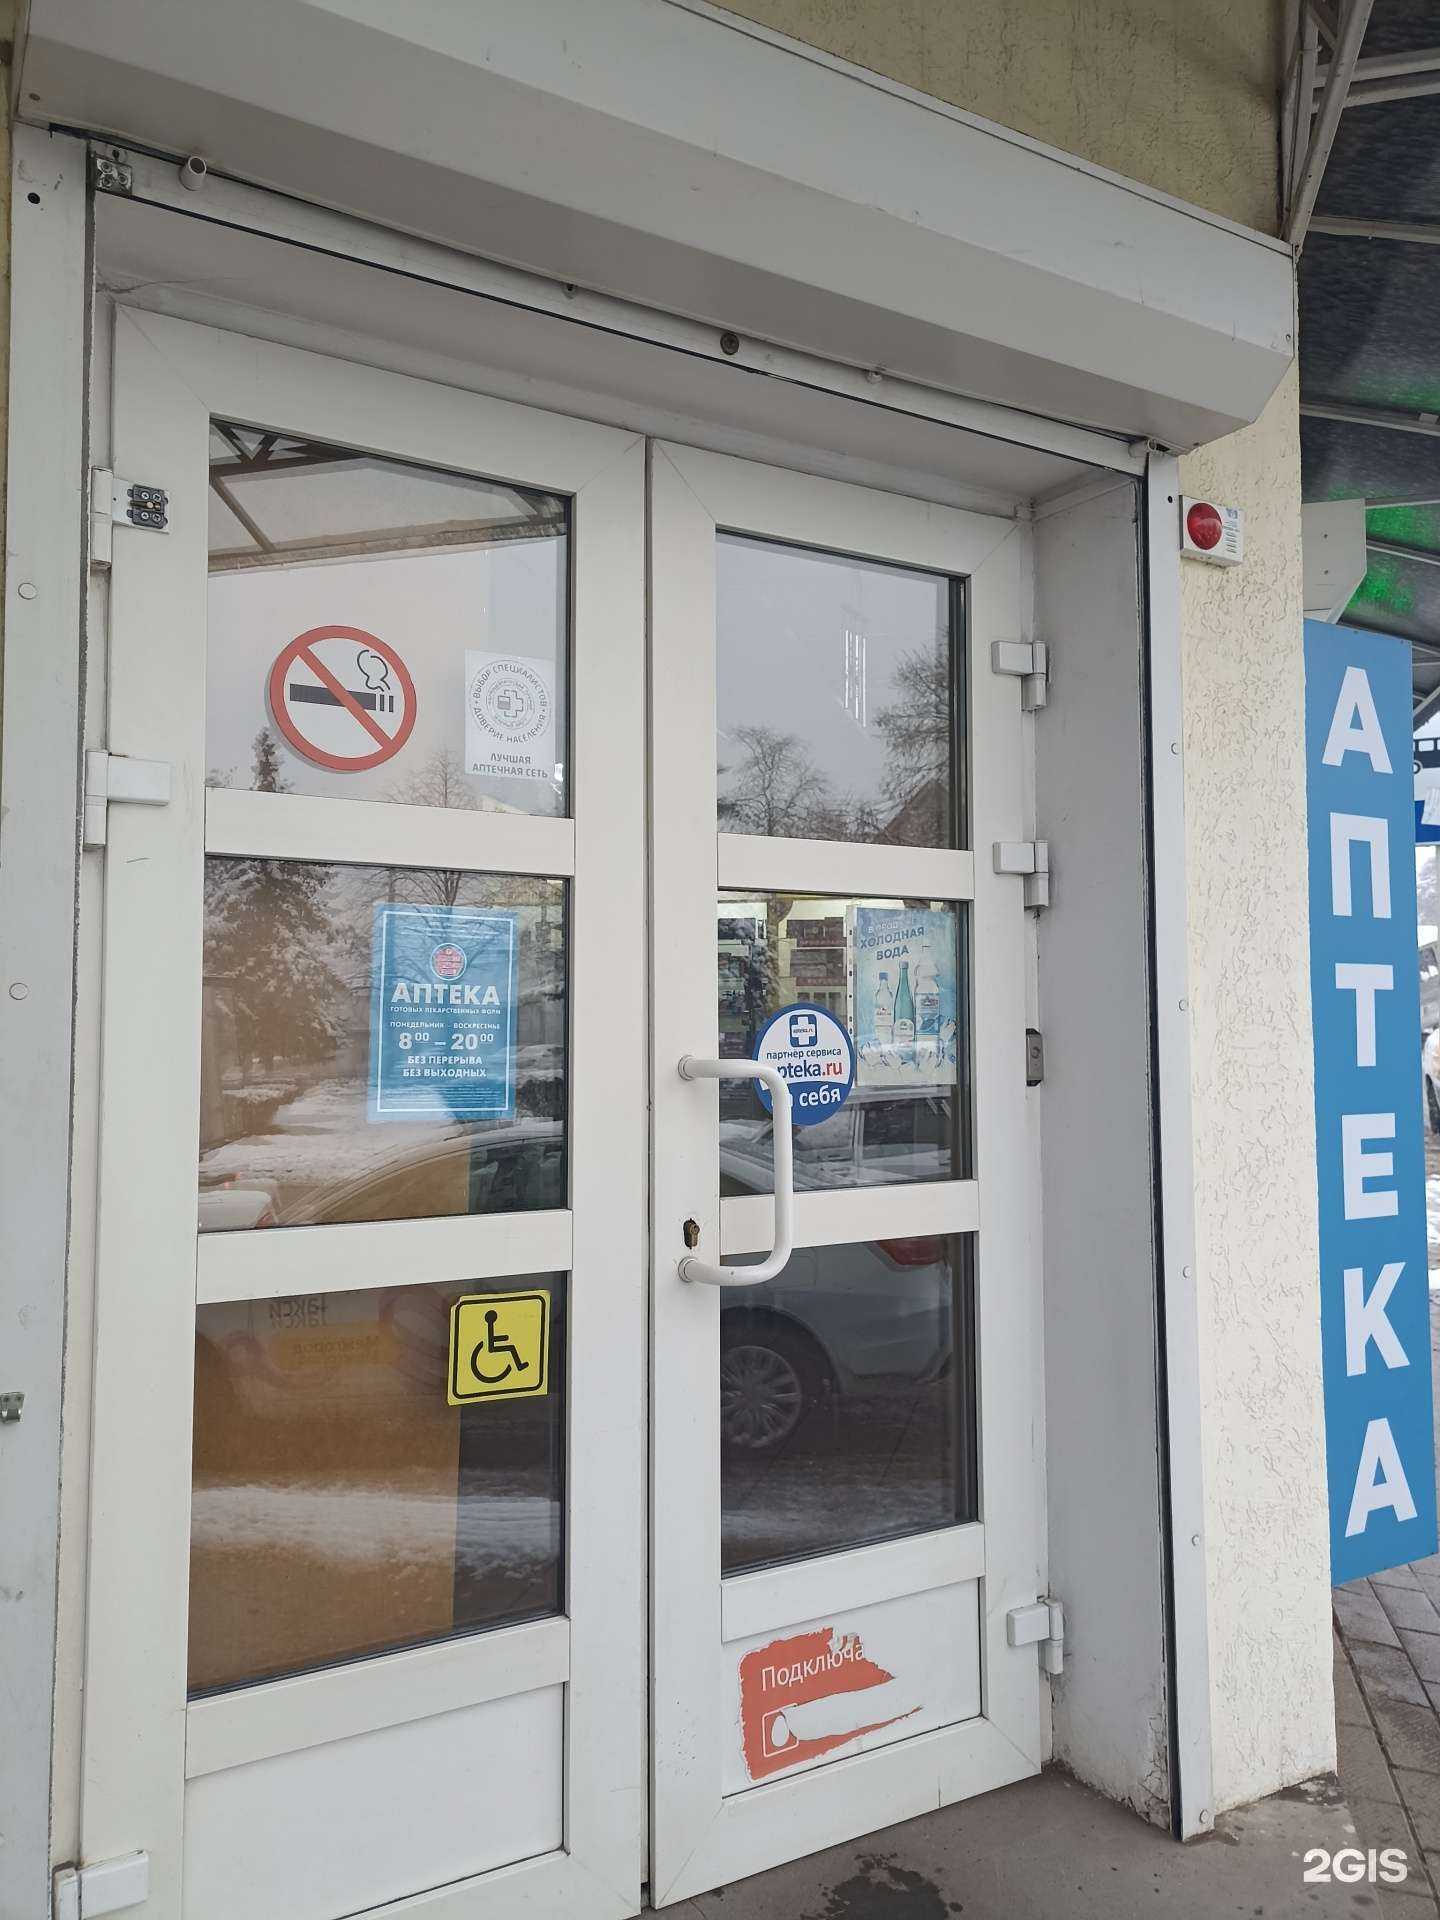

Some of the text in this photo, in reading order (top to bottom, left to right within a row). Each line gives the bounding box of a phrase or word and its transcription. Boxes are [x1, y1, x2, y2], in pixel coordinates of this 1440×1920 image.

[473, 670, 491, 699] ВЫБОР
[490, 752, 531, 765] ЛУЧШАЯ
[472, 763, 549, 778] АПТЕЧНАЯ СЕТЬ
[860, 926, 925, 949] ХОЛОДНАЯ
[876, 945, 910, 961] ВОДА
[390, 982, 501, 1006] АПТЕКА
[407, 1055, 483, 1066] БЕЗ ПЕРЕРЫВА
[806, 1047, 842, 1059] сервиса
[402, 1068, 487, 1078] БЕЗ ВЫХОДНЫХ
[776, 1059, 843, 1079] pteka.ru
[799, 1084, 841, 1107] себя
[1322, 665, 1418, 1538] АПТЕКА
